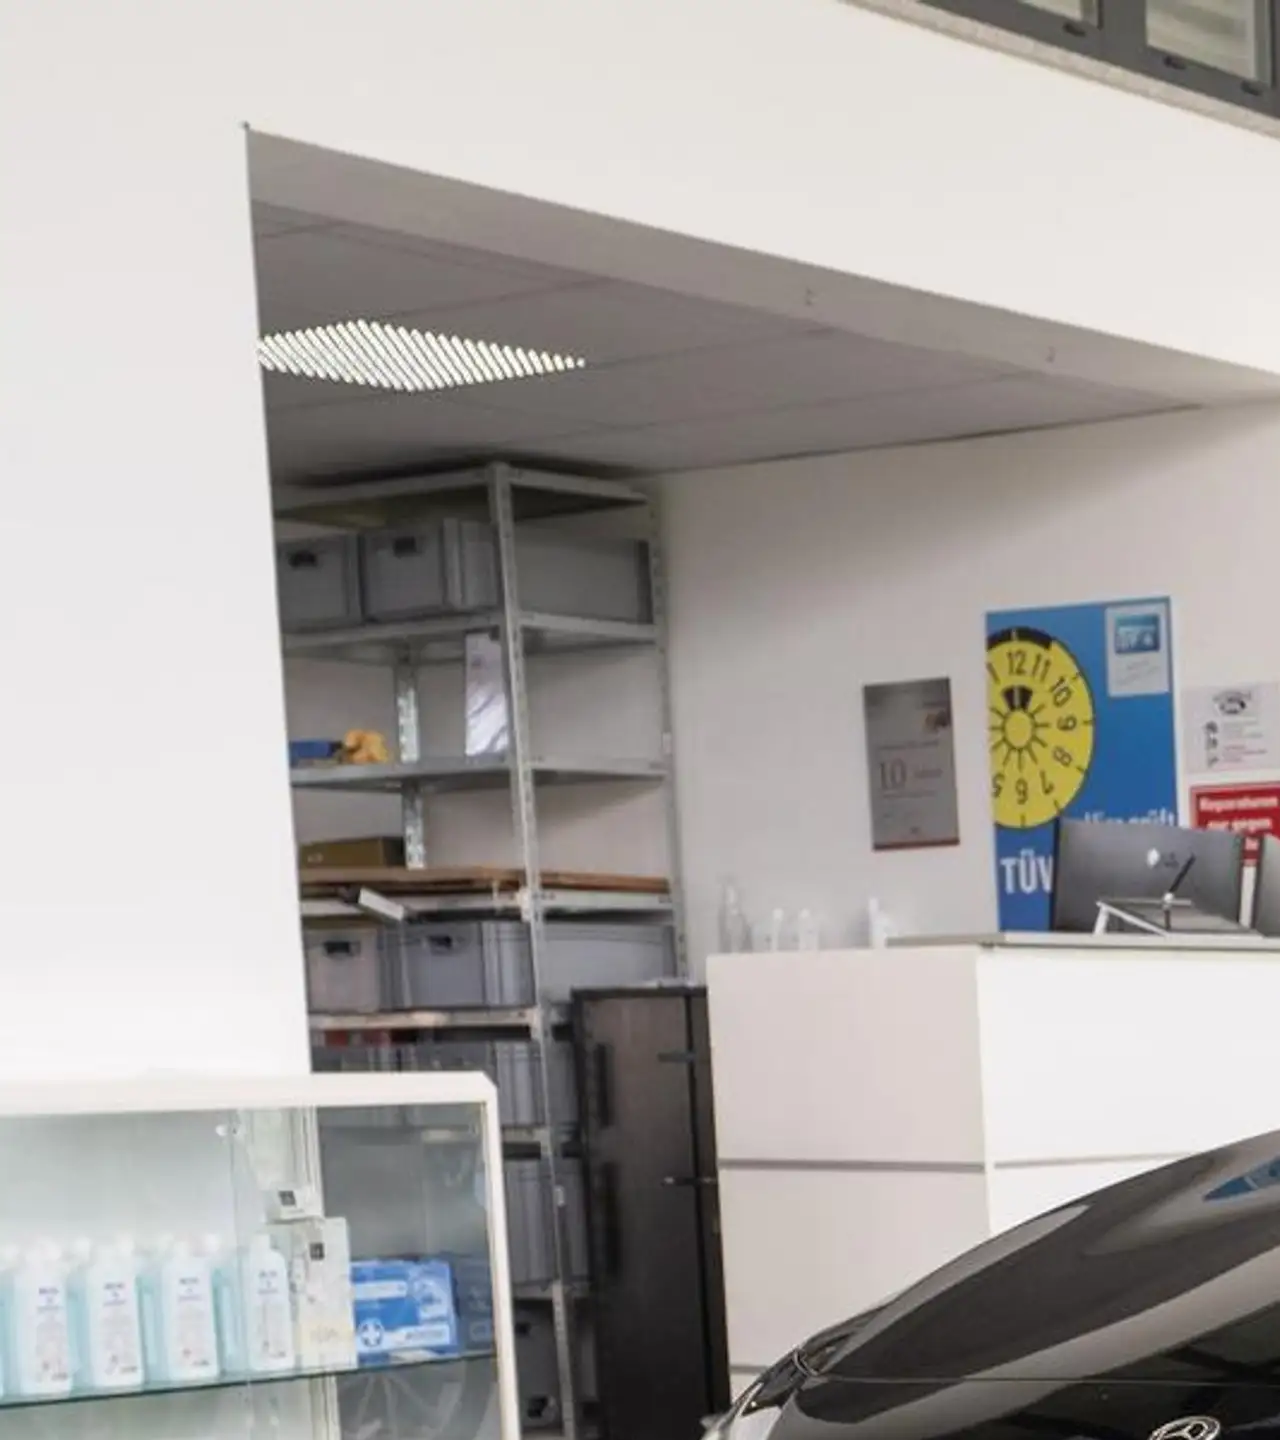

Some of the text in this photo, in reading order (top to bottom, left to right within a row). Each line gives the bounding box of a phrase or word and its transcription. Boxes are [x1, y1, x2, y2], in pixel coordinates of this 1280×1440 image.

[1007, 650, 1027, 675] 12
[1050, 676, 1072, 708] 10
[1000, 848, 1053, 894] TÜV
